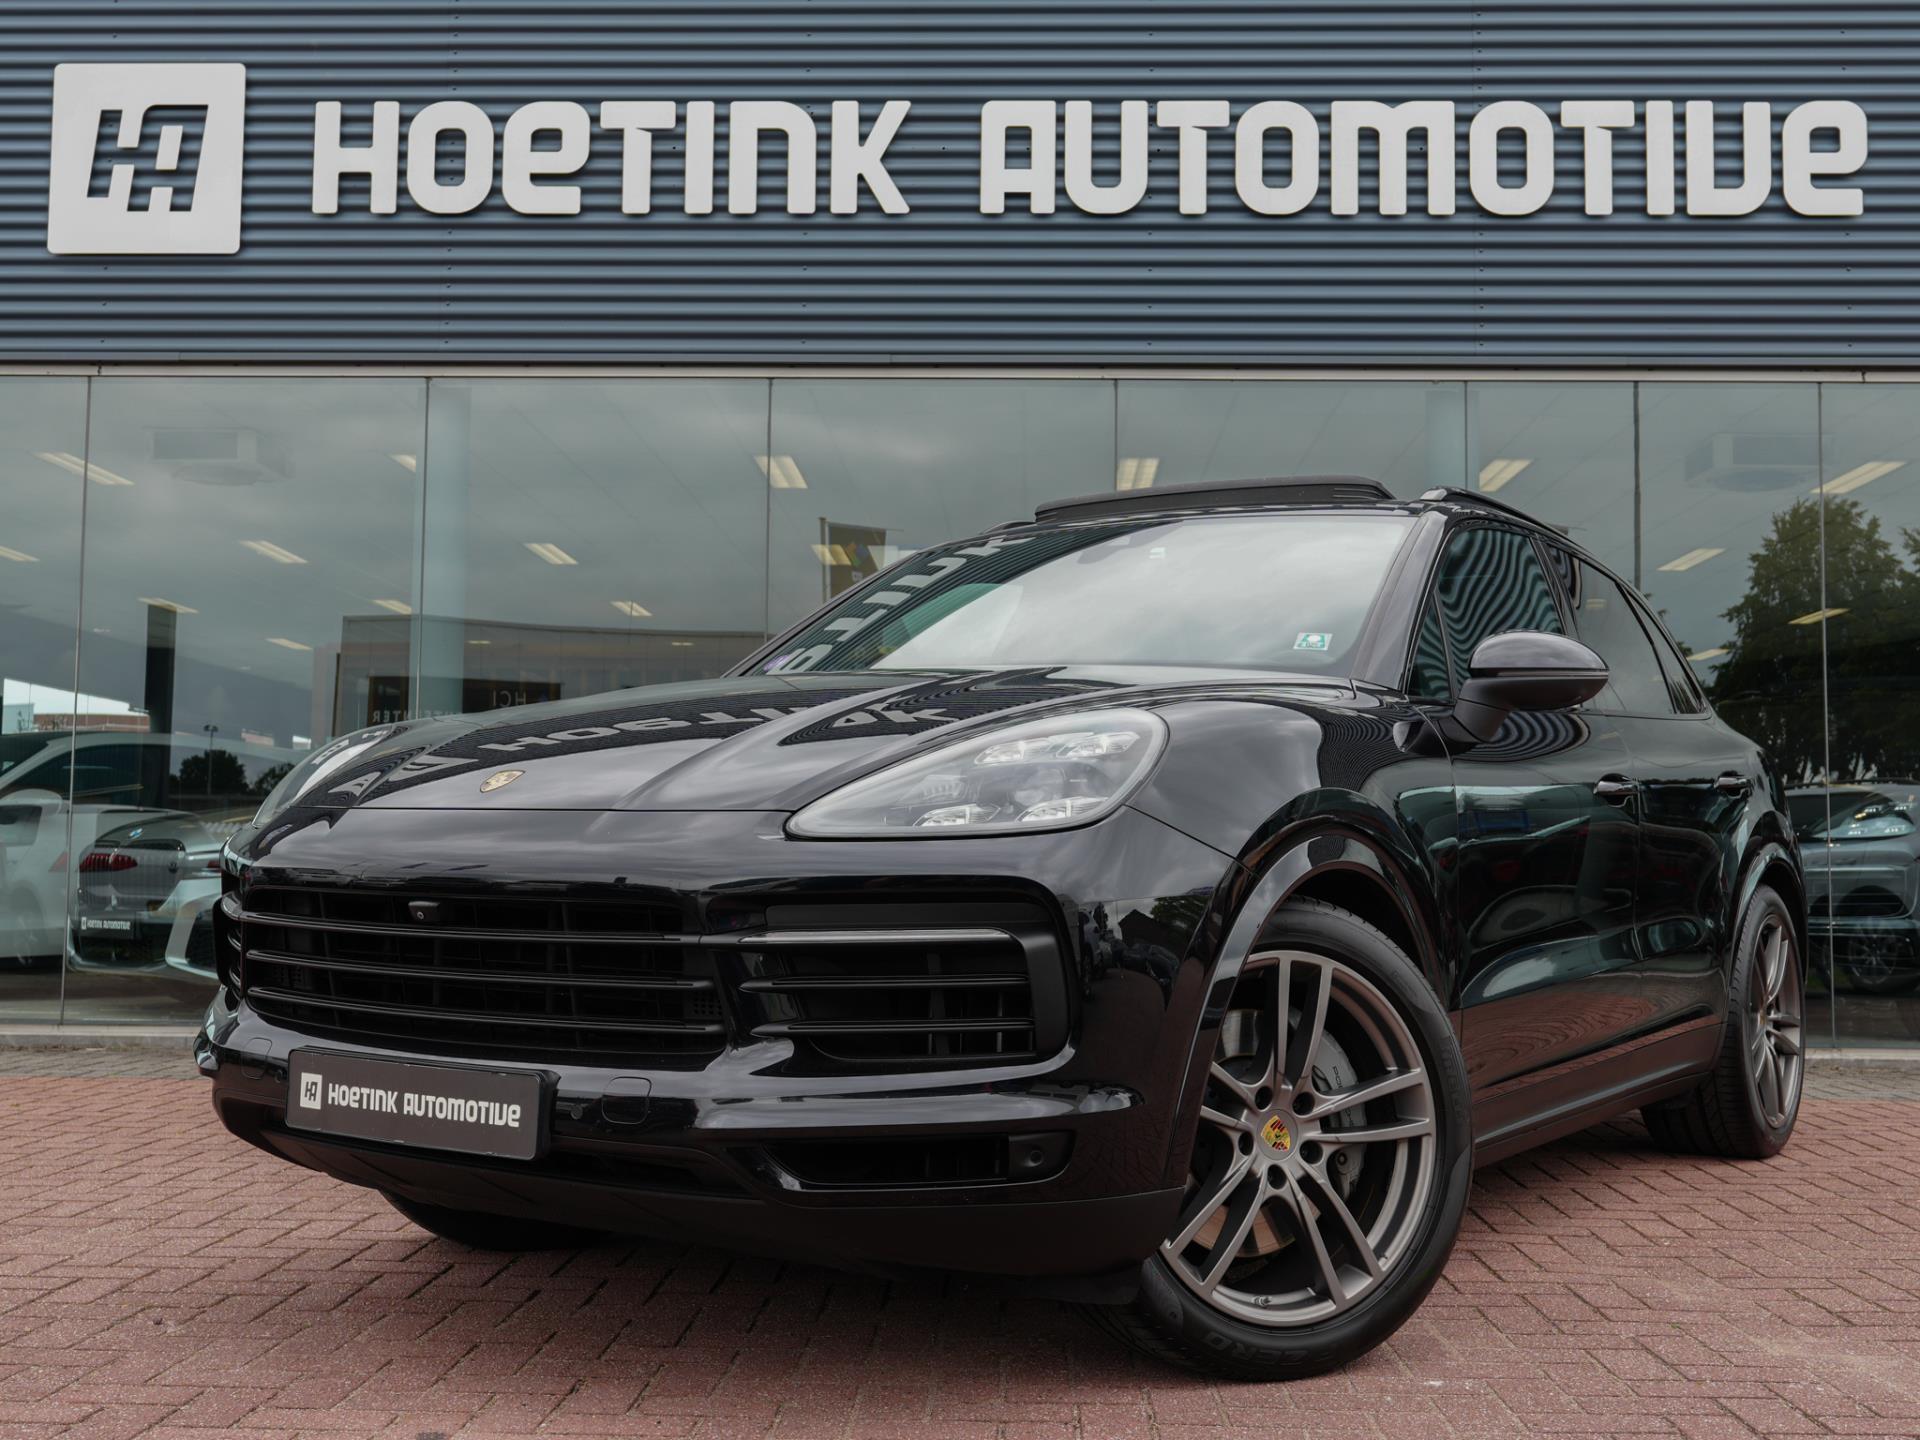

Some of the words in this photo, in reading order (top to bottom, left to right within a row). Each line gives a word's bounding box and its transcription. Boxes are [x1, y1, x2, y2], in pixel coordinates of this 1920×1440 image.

[311, 100, 912, 215] HOETINK
[980, 99, 1869, 217] AUTOMOTIVE
[327, 1082, 398, 1114] HOETINK
[403, 1092, 521, 1127] AUTOMOTIVE
